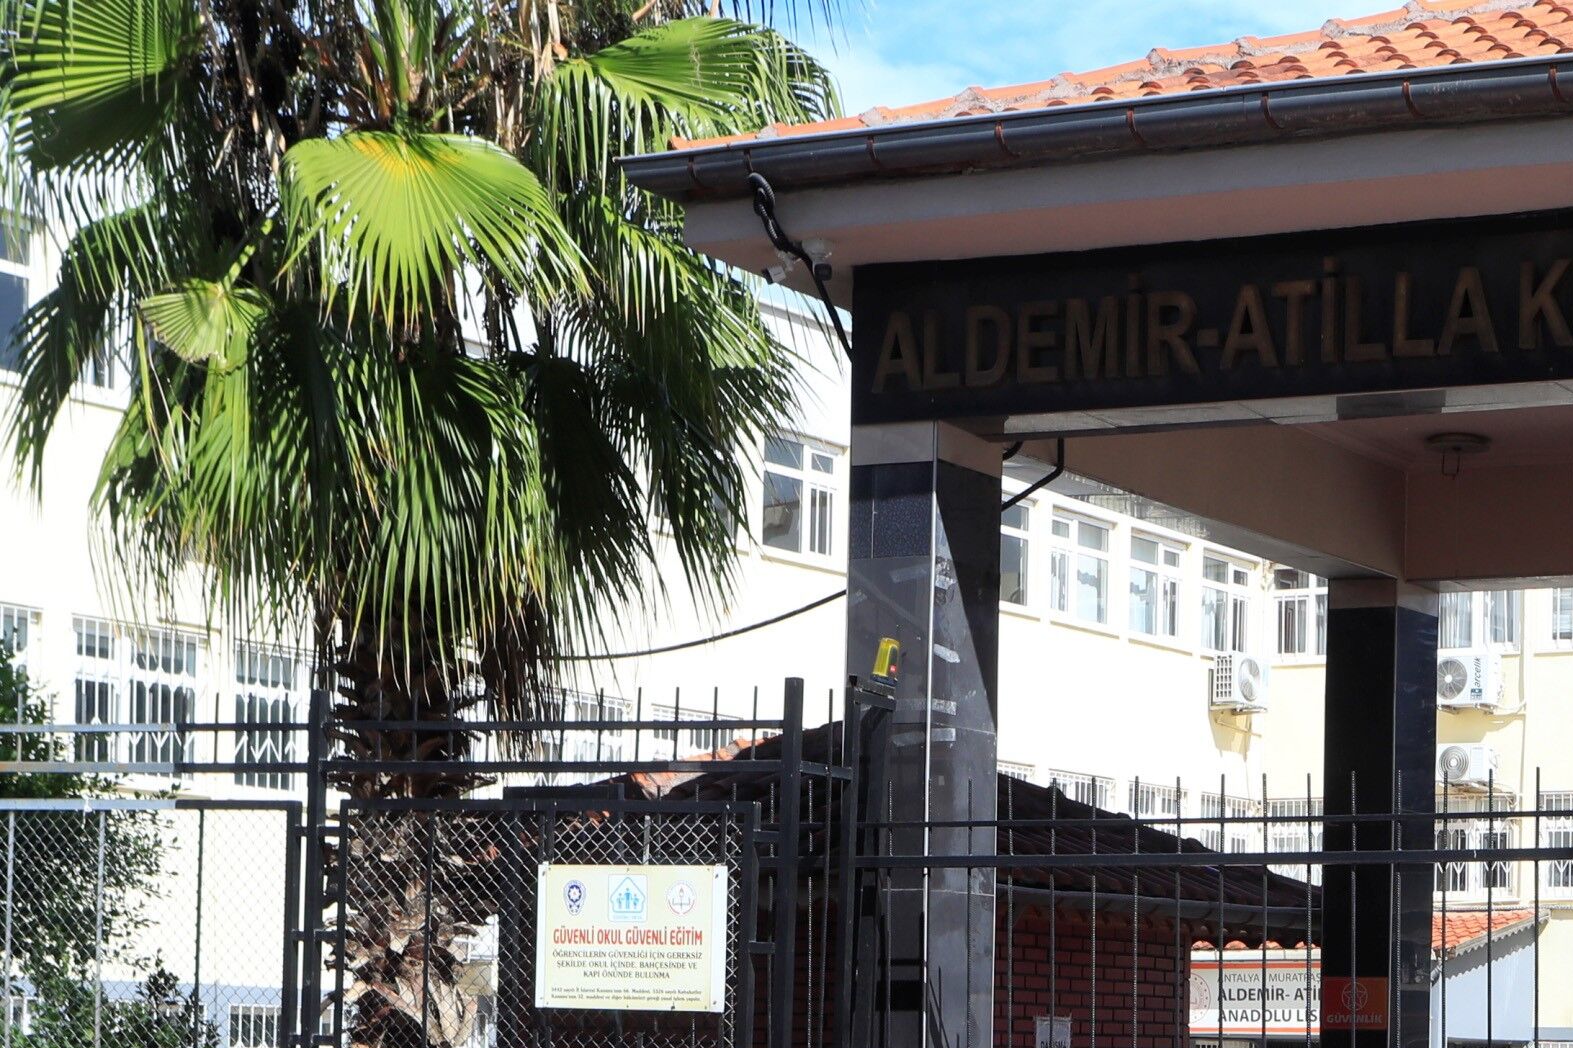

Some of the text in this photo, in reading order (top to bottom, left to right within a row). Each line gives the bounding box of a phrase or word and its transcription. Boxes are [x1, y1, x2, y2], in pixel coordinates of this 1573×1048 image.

[553, 924, 703, 946] GÜVENLİ OKUL GÜVENLİ EĞİTİM
[1217, 973, 1260, 983] NTALYA
[1327, 1011, 1383, 1024] GÜVNLİK
